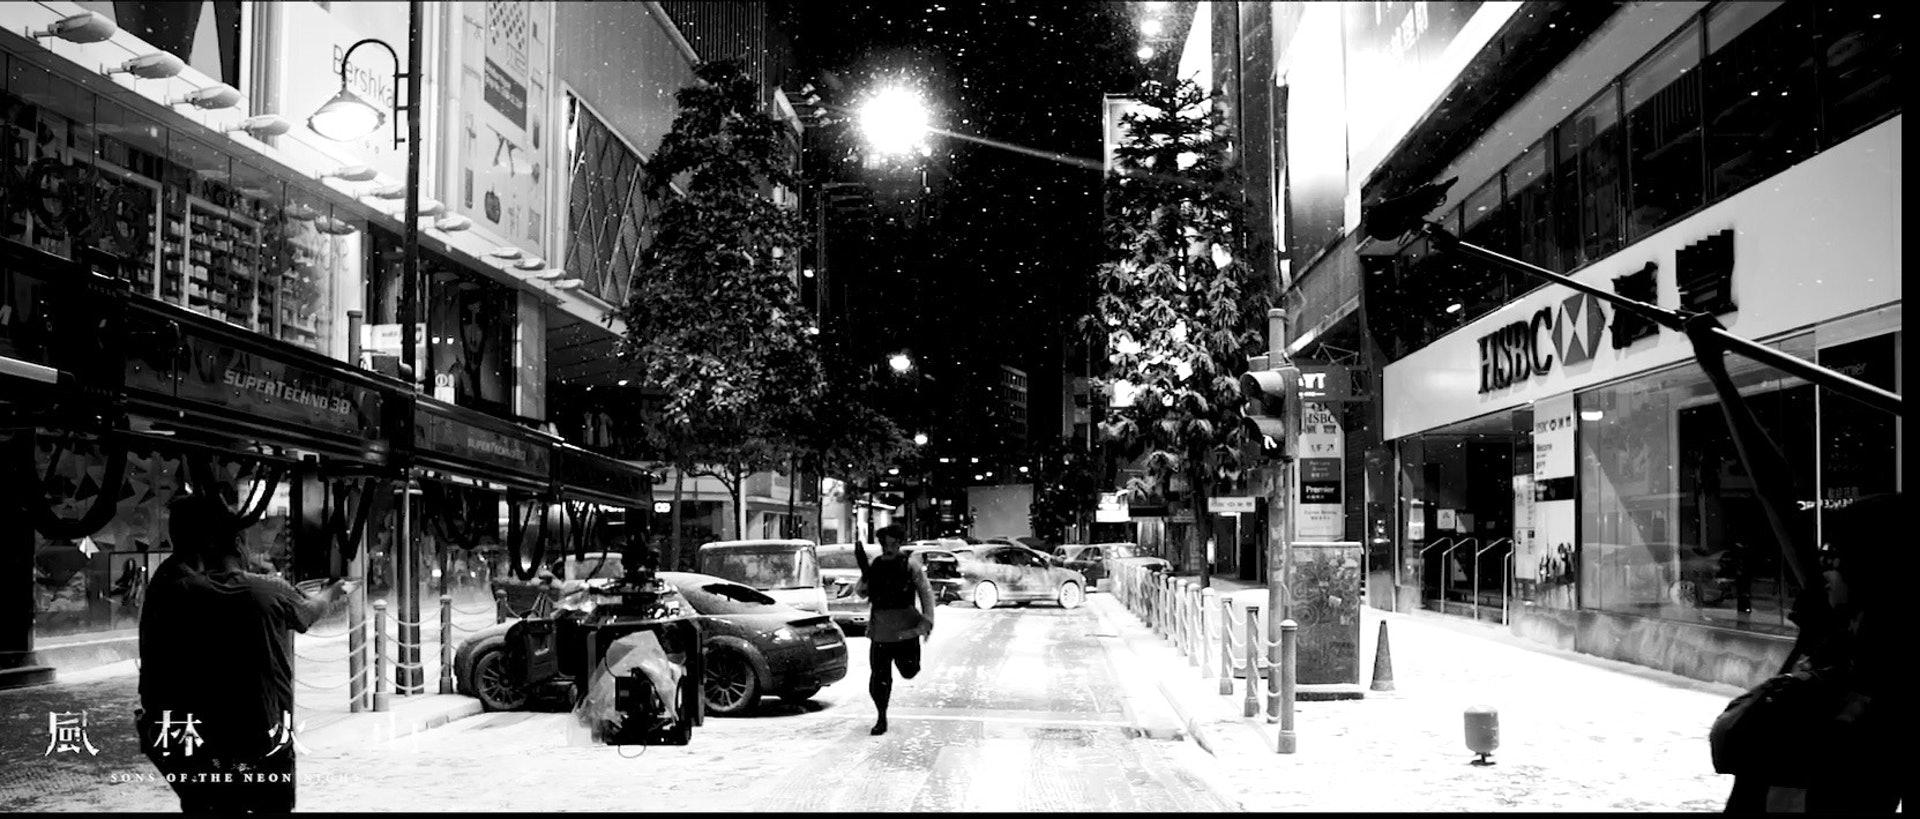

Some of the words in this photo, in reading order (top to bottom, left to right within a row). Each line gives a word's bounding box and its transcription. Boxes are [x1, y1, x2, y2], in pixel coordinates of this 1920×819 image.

[333, 43, 394, 109] Bershka
[1478, 306, 1553, 394] HSBC
[224, 369, 328, 410] SUPERTECHNO
[1305, 485, 1335, 496] Premier
